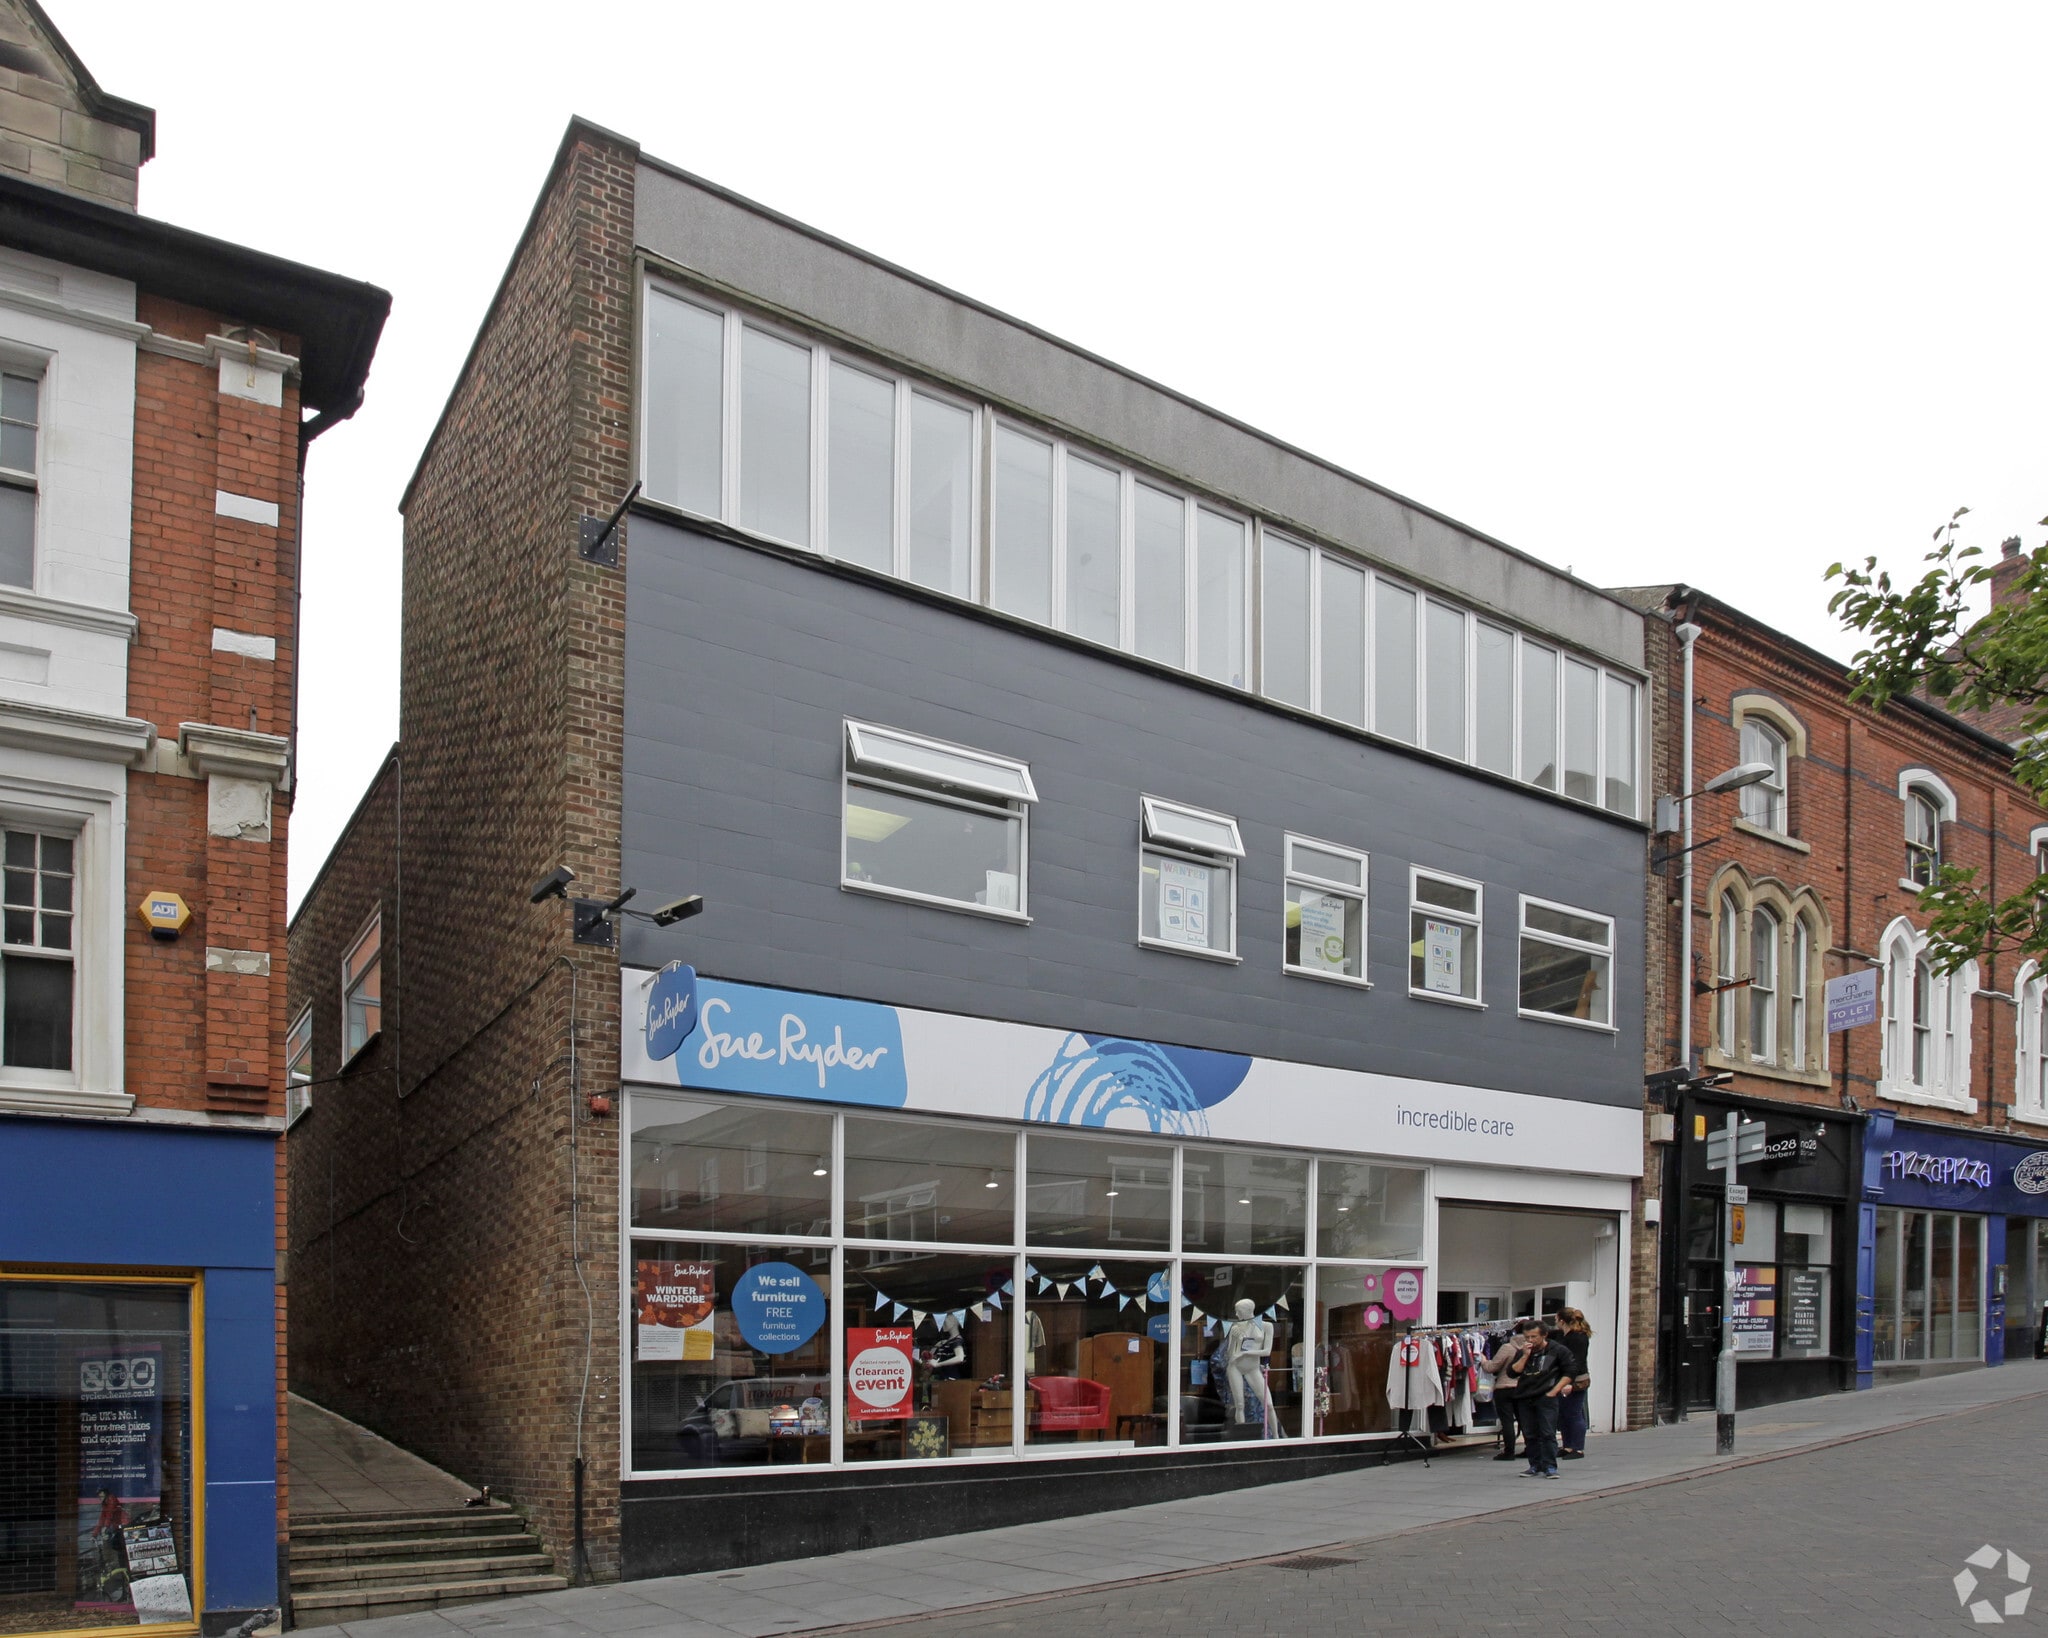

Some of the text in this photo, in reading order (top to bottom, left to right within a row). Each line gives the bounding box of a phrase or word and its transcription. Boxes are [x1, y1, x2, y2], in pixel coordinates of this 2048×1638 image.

[1163, 863, 1206, 880] WANTED
[152, 904, 176, 915] ADT
[1428, 922, 1459, 936] WANTED
[649, 992, 690, 1041] Sue Ryder
[1832, 1010, 1846, 1019] TO
[1850, 1004, 1871, 1016] LET
[698, 998, 888, 1088] Sue Ryder
[1397, 1104, 1515, 1137] incredible care
[1765, 1139, 1797, 1153] no28
[1729, 1187, 1746, 1195] Except
[674, 1263, 711, 1279] Sue Ryder
[758, 1276, 800, 1287] We sell
[655, 1286, 697, 1295] WINTER
[646, 1294, 705, 1303] WARDROBE
[751, 1291, 807, 1303] furniture
[766, 1307, 793, 1318] FREE
[1733, 1301, 1750, 1317] ent!
[762, 1321, 796, 1330] furniture
[758, 1332, 800, 1341] collections
[876, 1329, 911, 1344] Sue Ryder
[855, 1367, 904, 1376] Clearance
[855, 1376, 905, 1391] event
[80, 1389, 155, 1401] cyclescheme.co.uk
[81, 1412, 97, 1421] The
[100, 1411, 117, 1421] UK's
[81, 1421, 151, 1432] for tax-free bikes
[81, 1433, 146, 1445] and equipment
